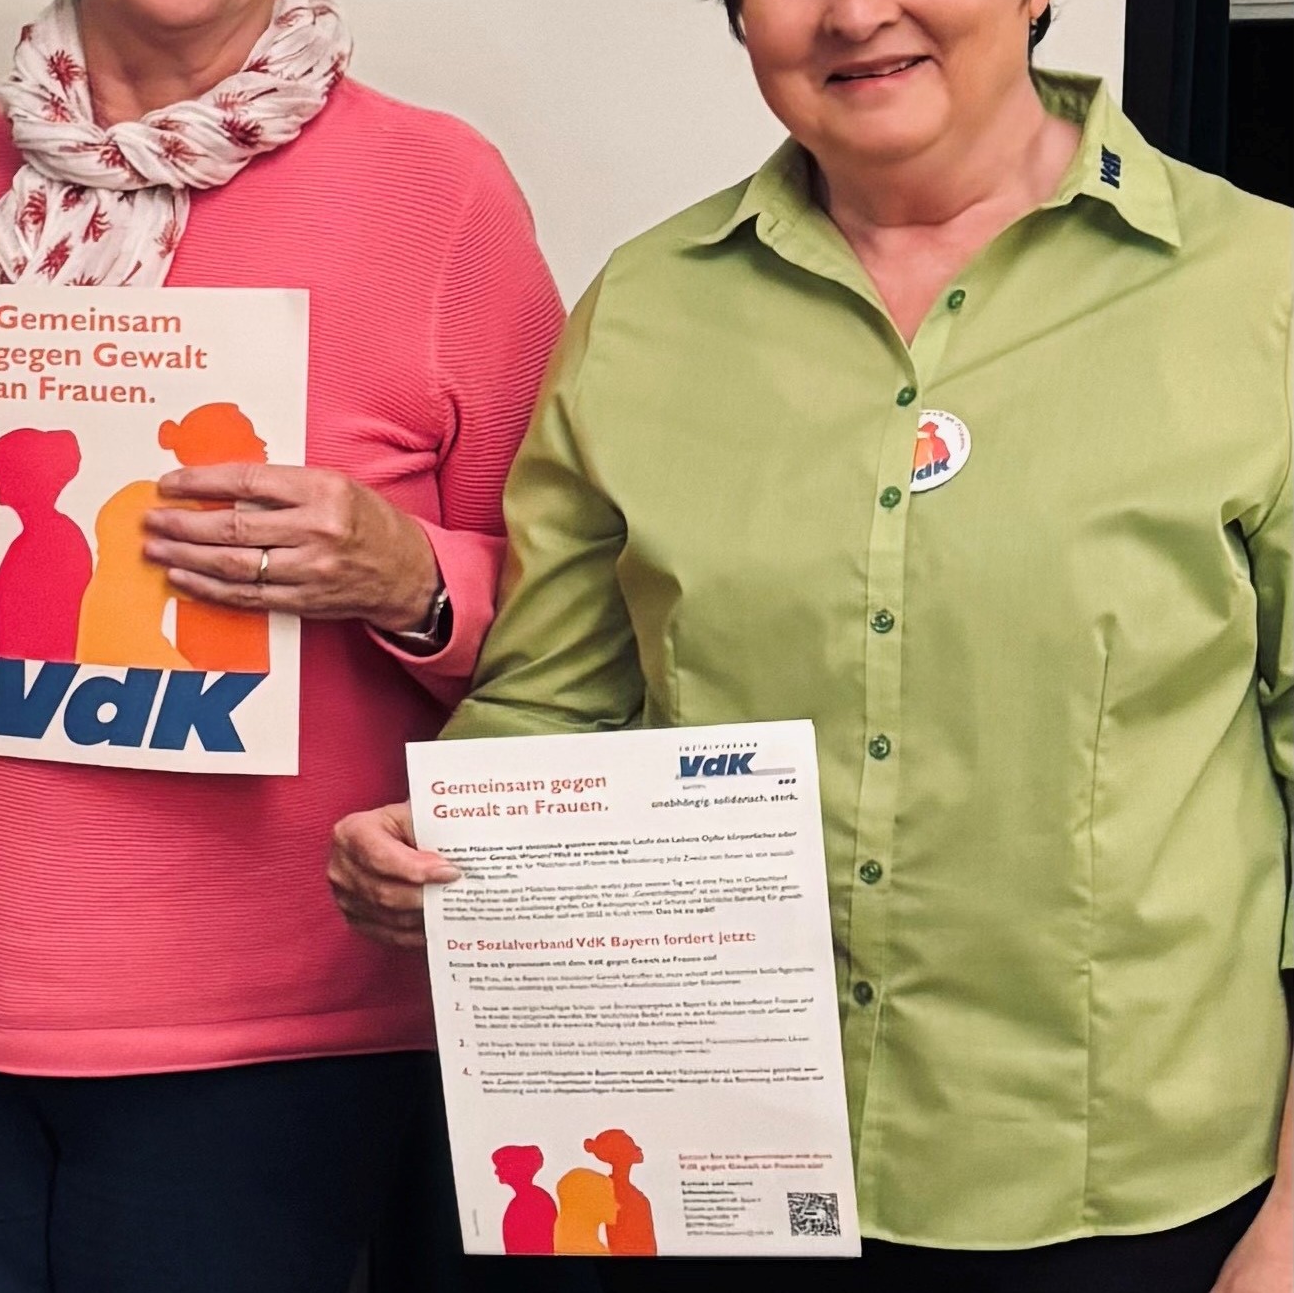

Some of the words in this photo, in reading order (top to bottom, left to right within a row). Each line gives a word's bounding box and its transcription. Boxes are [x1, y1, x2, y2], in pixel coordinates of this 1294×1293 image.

[93, 343, 207, 370] Gewalt
[39, 377, 156, 404] Frauen.
[911, 458, 950, 483] dK
[679, 752, 756, 777] VdK
[431, 779, 545, 795] Gemeinsam
[551, 776, 607, 794] gegen
[433, 803, 501, 818] Gewalt
[506, 805, 528, 816] an
[535, 800, 609, 814] Frauen.
[447, 939, 473, 951] Der
[477, 937, 573, 951] Sozialverband
[576, 936, 605, 948] VdK
[611, 935, 660, 949] Bayern
[664, 934, 714, 945] fordert
[719, 931, 756, 945] jetzt:
